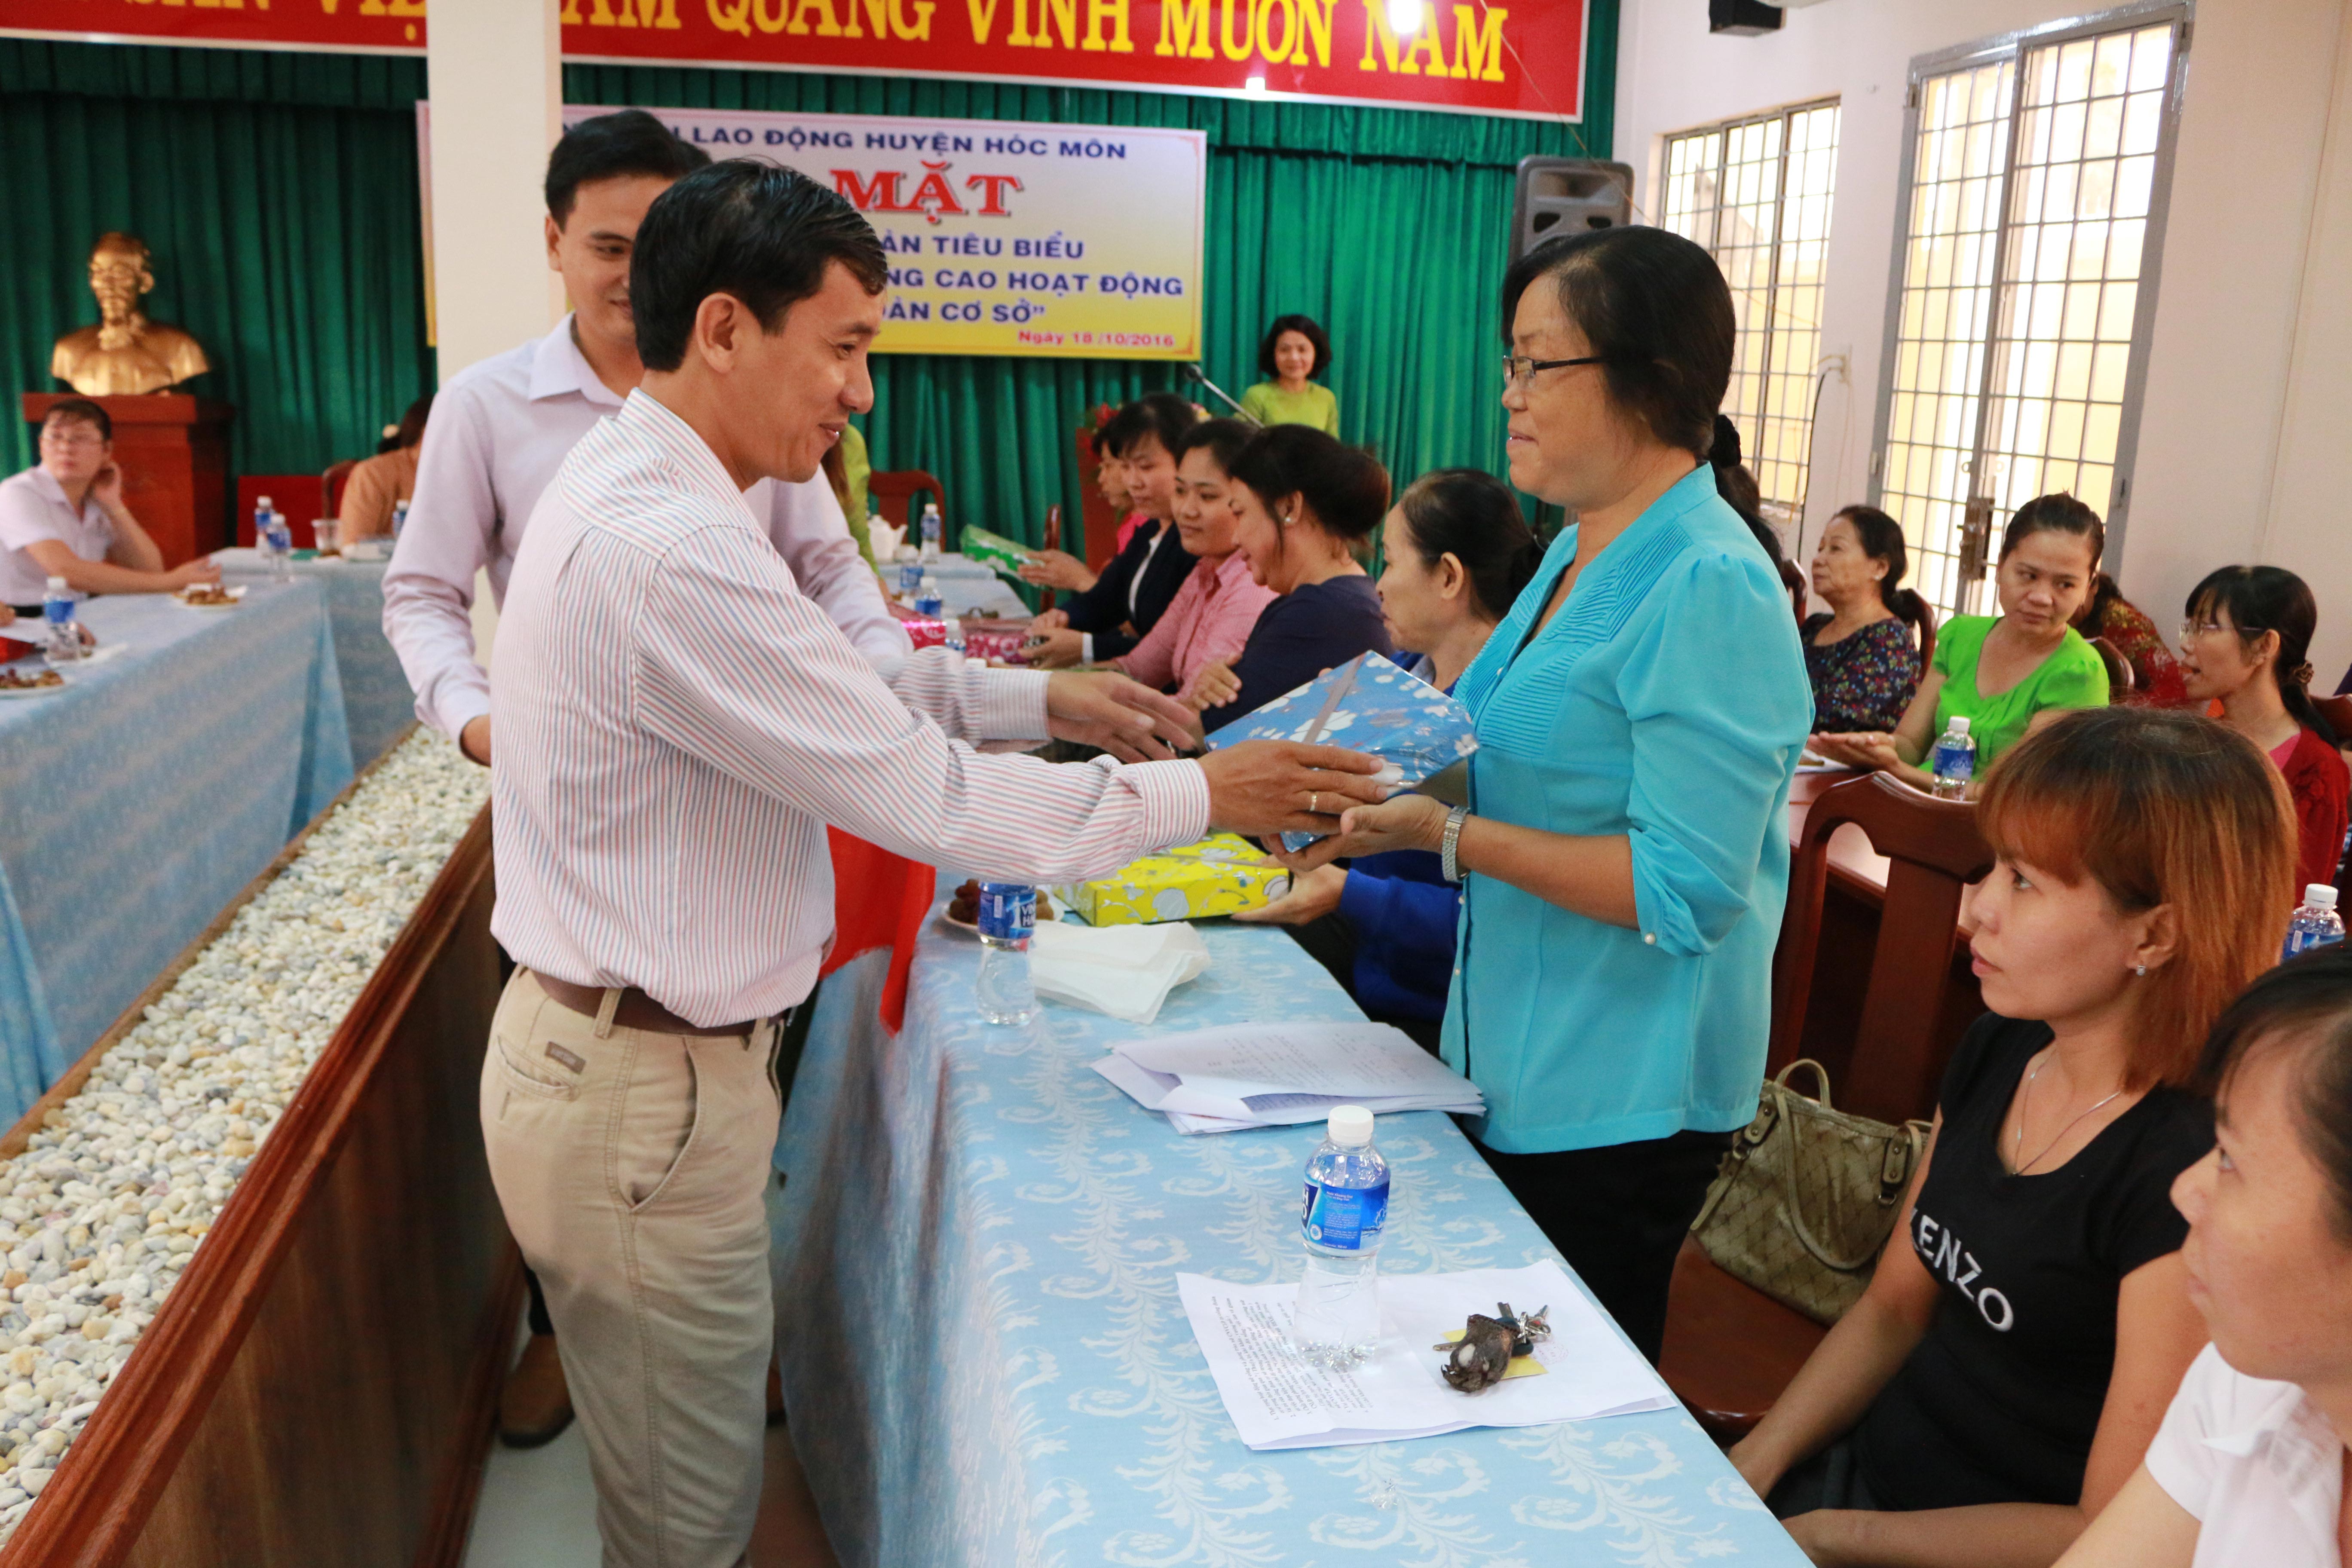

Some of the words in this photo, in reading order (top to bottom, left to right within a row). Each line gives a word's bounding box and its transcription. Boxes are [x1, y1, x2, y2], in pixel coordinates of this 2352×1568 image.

[965, 0, 1134, 52] VINH
[693, 127, 753, 145] LAO
[765, 126, 853, 151] ĐỘNG
[865, 132, 973, 156] HUYỆN
[985, 133, 1047, 155] HÓC
[1059, 138, 1126, 159] MÔN
[830, 160, 1023, 224] MẶT
[932, 232, 1002, 256] TIÊU
[1014, 230, 1083, 258] BIỂU
[887, 268, 924, 287] NG
[935, 269, 996, 288] CAO
[1008, 272, 1090, 297] HOẠT
[1099, 271, 1182, 299] ĐỘNG
[941, 300, 981, 322] CƠ
[1018, 331, 1064, 345] Ngày
[1073, 332, 1093, 345] 18
[1910, 1207, 2014, 1332] ENZO
